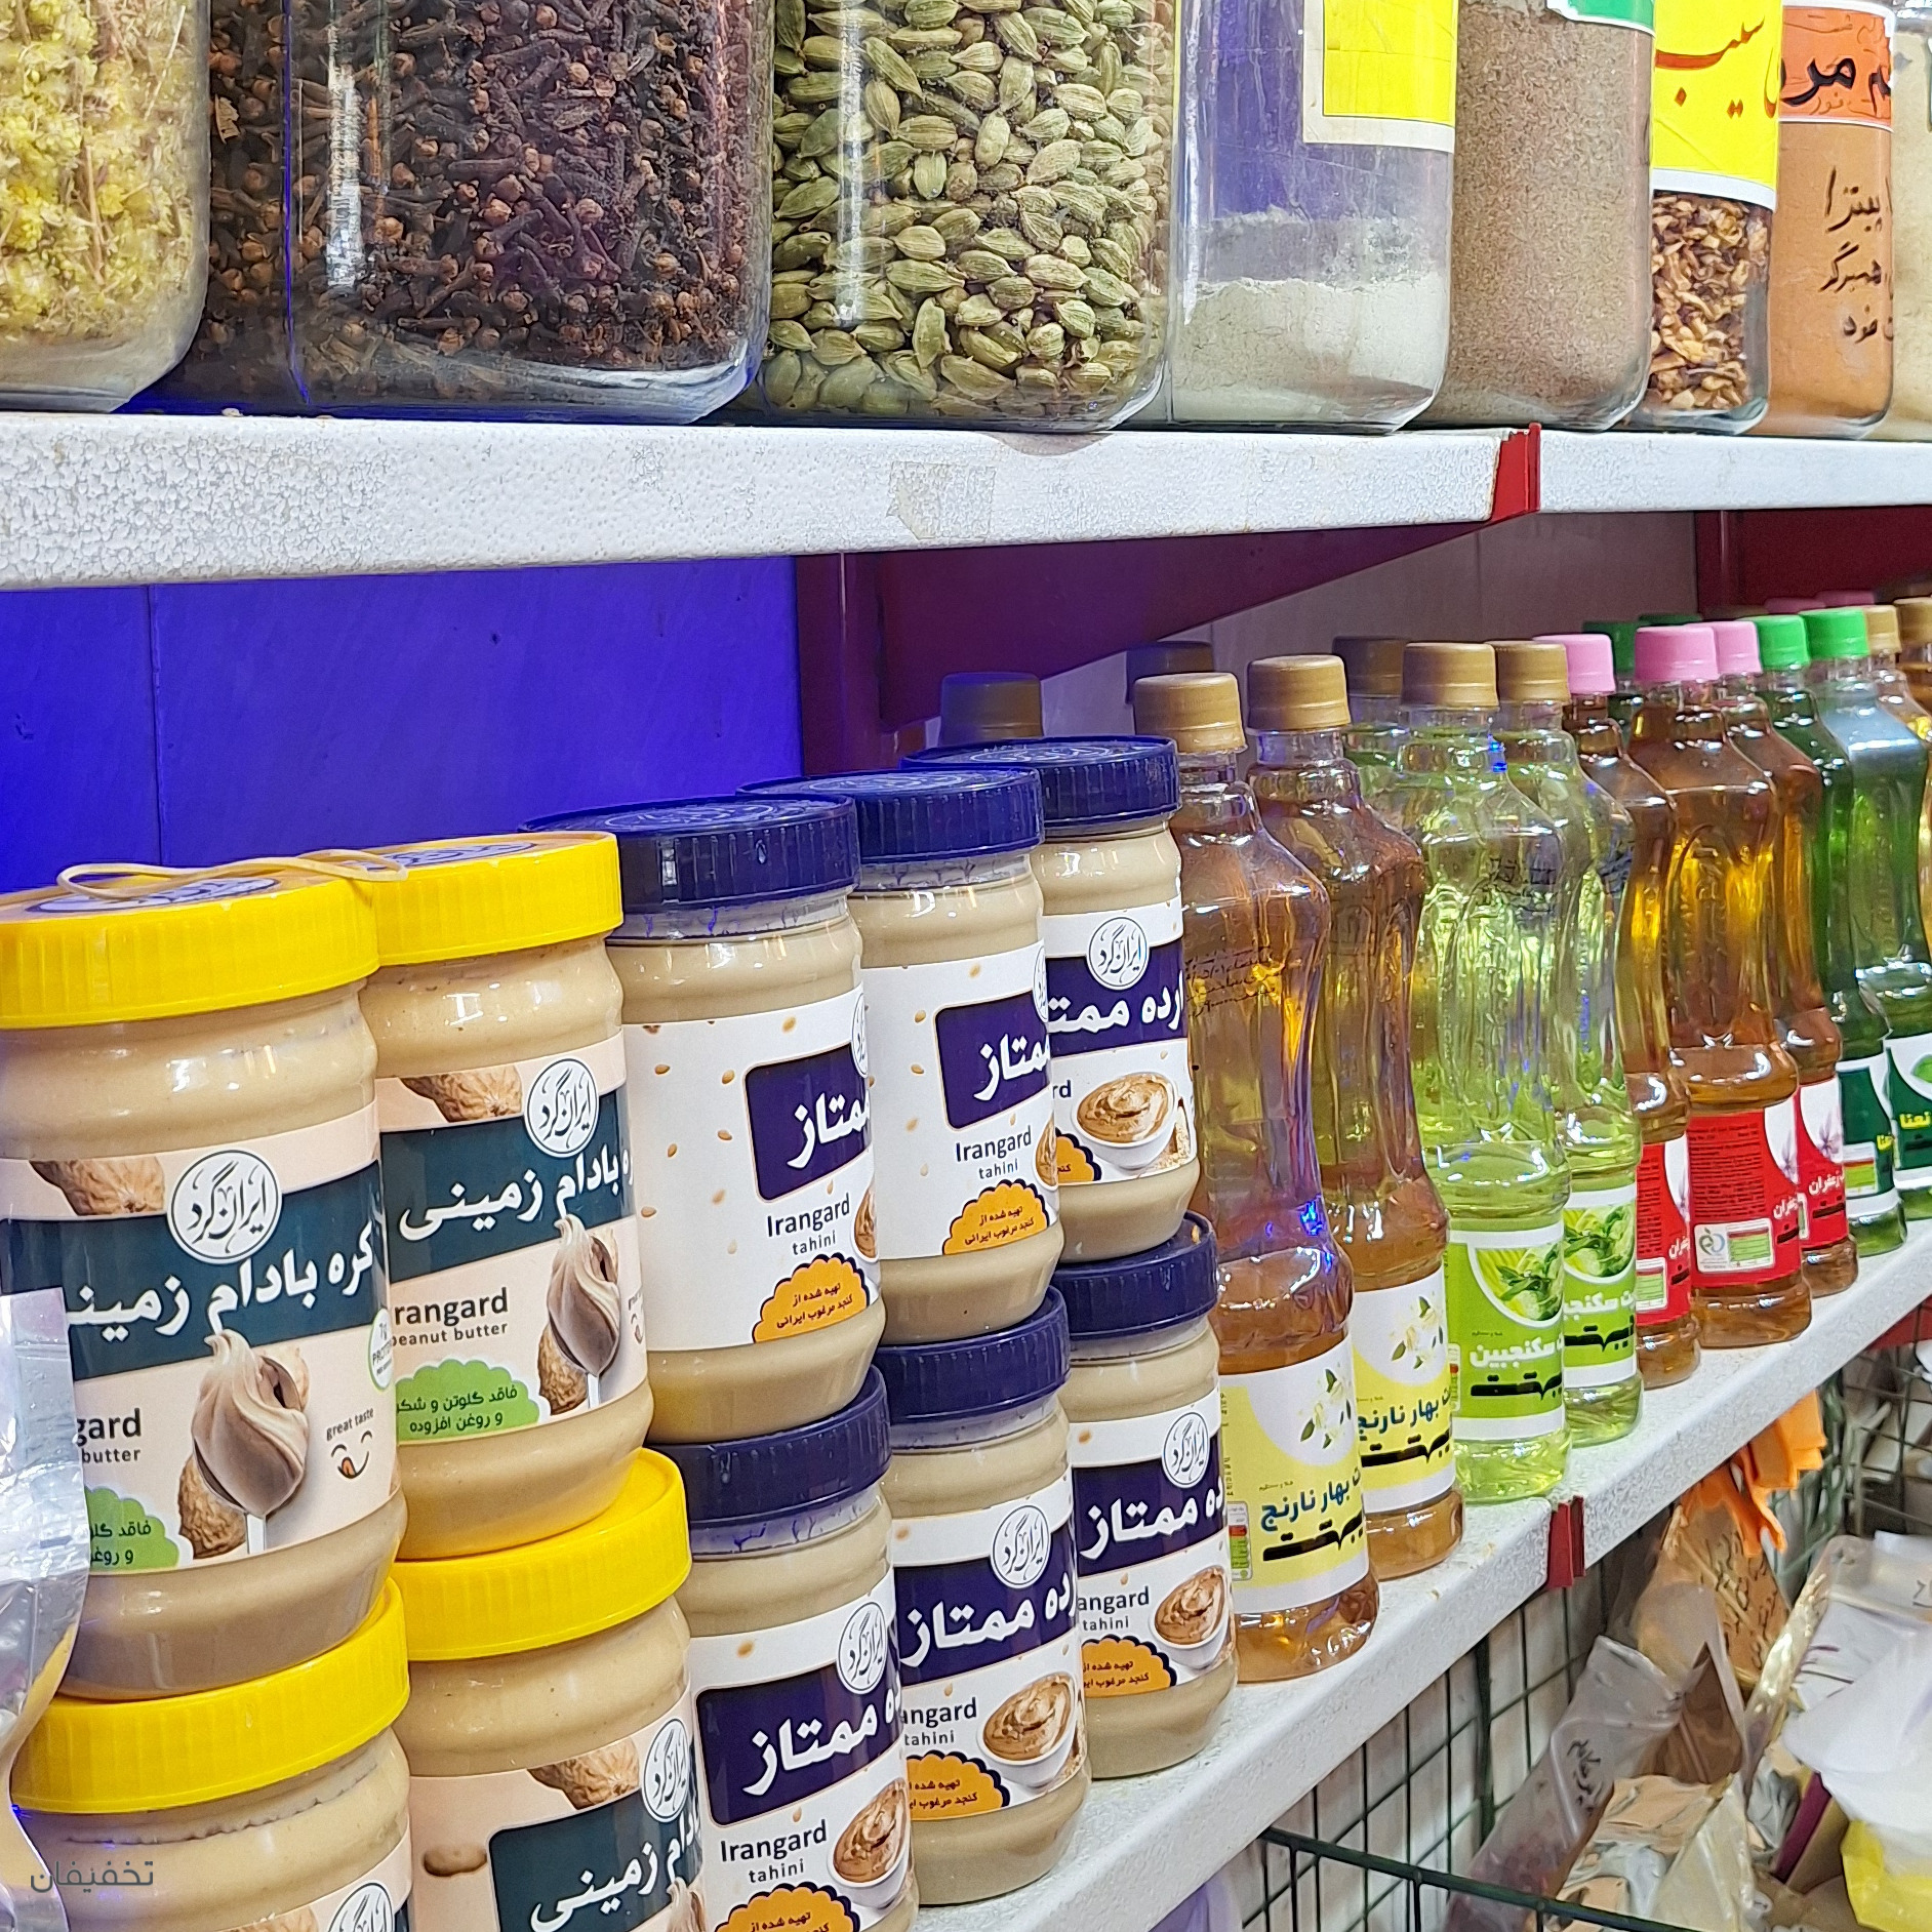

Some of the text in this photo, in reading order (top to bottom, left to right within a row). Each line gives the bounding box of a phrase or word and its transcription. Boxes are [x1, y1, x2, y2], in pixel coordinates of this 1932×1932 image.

[1048, 996, 1130, 1033] ممت
[955, 1124, 1031, 1162] Irangard
[555, 1143, 619, 1214] بادام
[979, 1158, 1018, 1179] tahini
[400, 1168, 543, 1241] زمینی
[767, 1192, 850, 1237] Irangard
[979, 1214, 987, 1226] از
[989, 1210, 1006, 1221] شده
[792, 1229, 836, 1255] tahini
[964, 1231, 991, 1245] ایرانی
[207, 1247, 318, 1335] بادام
[792, 1294, 801, 1307] از
[803, 1289, 822, 1302] شده
[66, 1274, 190, 1342] زمین
[394, 1286, 508, 1327] rangard
[776, 1311, 806, 1329] ایرانی
[454, 1323, 508, 1341] butter
[1469, 1336, 1556, 1369] سکنجبین
[443, 1390, 485, 1412] گلوتن
[489, 1384, 518, 1403] فاقد
[430, 1399, 438, 1414] و
[1409, 1398, 1439, 1428] بهار
[327, 1407, 374, 1442] great taste
[410, 1411, 503, 1435] و روغن افزوده
[1261, 1480, 1350, 1532] بهار نارنج
[118, 1519, 151, 1537] فاقد
[1079, 1497, 1198, 1560] ممتاز
[125, 1549, 134, 1564] و
[1078, 1585, 1149, 1615] angard
[900, 1598, 1035, 1668] ممتاز
[1082, 1615, 1129, 1631] tahini
[1092, 1662, 1112, 1671] شده
[1113, 1661, 1134, 1671] تهیه
[1129, 1672, 1149, 1684] کنجد
[904, 1729, 954, 1746] tahini
[743, 1704, 878, 1796] ممتاز
[914, 1780, 936, 1790] شده
[938, 1779, 960, 1791] تهیه
[919, 1797, 952, 1810] مرغوب
[954, 1791, 978, 1805] کنجد
[720, 1819, 827, 1862] Irangard
[748, 1858, 804, 1883] tahini
[762, 1917, 785, 1929] شده
[788, 1912, 811, 1926] تهیه
